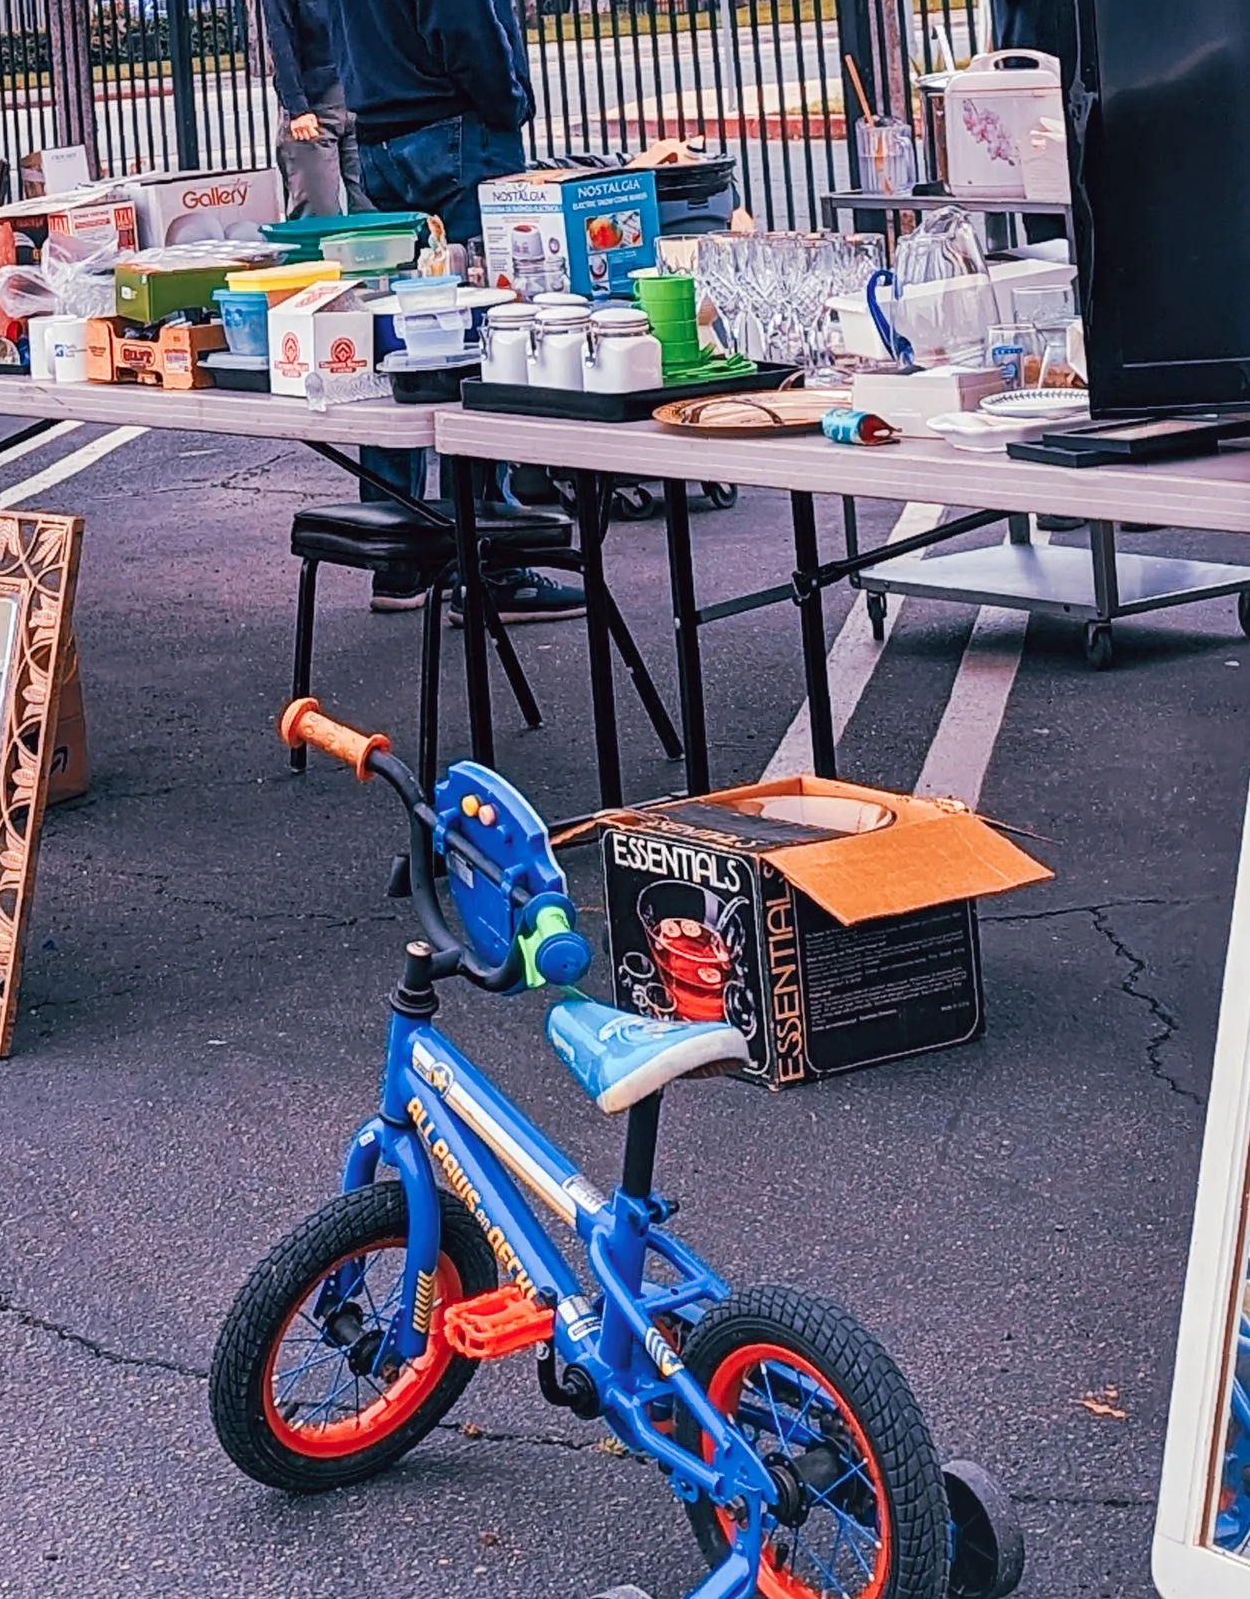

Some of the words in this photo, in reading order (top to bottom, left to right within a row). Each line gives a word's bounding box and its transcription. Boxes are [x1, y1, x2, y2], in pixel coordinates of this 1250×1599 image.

[183, 183, 248, 209] Gallery
[492, 191, 547, 202] NOSTALGIA
[578, 179, 641, 199] NOSTALGIA
[612, 832, 741, 893] ESSENTIALS
